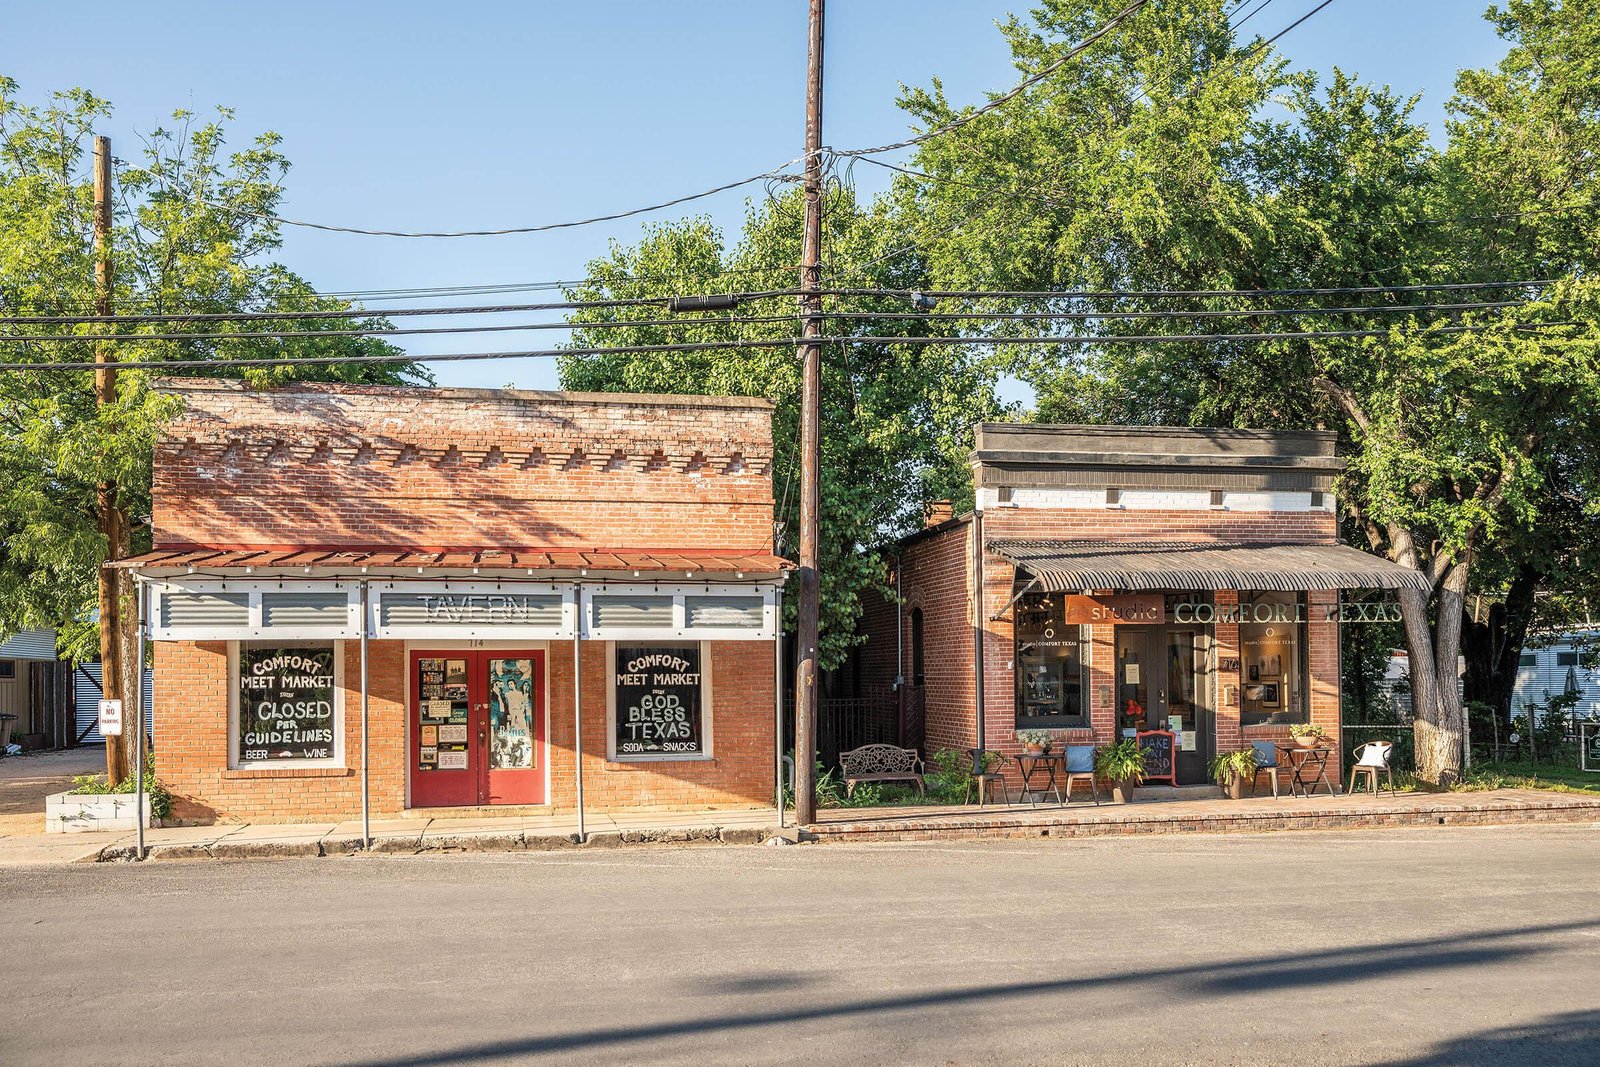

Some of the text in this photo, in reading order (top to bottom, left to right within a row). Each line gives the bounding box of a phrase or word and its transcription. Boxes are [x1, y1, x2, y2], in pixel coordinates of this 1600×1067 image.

[417, 595, 528, 624] TAVERN
[1091, 604, 1158, 620] studio
[1174, 603, 1403, 623] COMFORT TEXAS
[468, 639, 484, 647] 714
[253, 656, 322, 675] COMFORT
[627, 654, 690, 673] COMFORT
[241, 675, 333, 689] MEET MARKET
[617, 673, 700, 686] MEET MARKET
[640, 694, 680, 710] GOD
[105, 708, 115, 716] NO
[258, 701, 331, 720] CLOSED
[629, 706, 686, 722] BLESS
[276, 720, 298, 729] PER
[625, 721, 691, 740] TEXAS
[244, 729, 333, 746] GUIDELINES
[1140, 738, 1169, 750] MAKE
[245, 748, 328, 760] BEER WINE
[623, 742, 697, 752] SODA SNACKS
